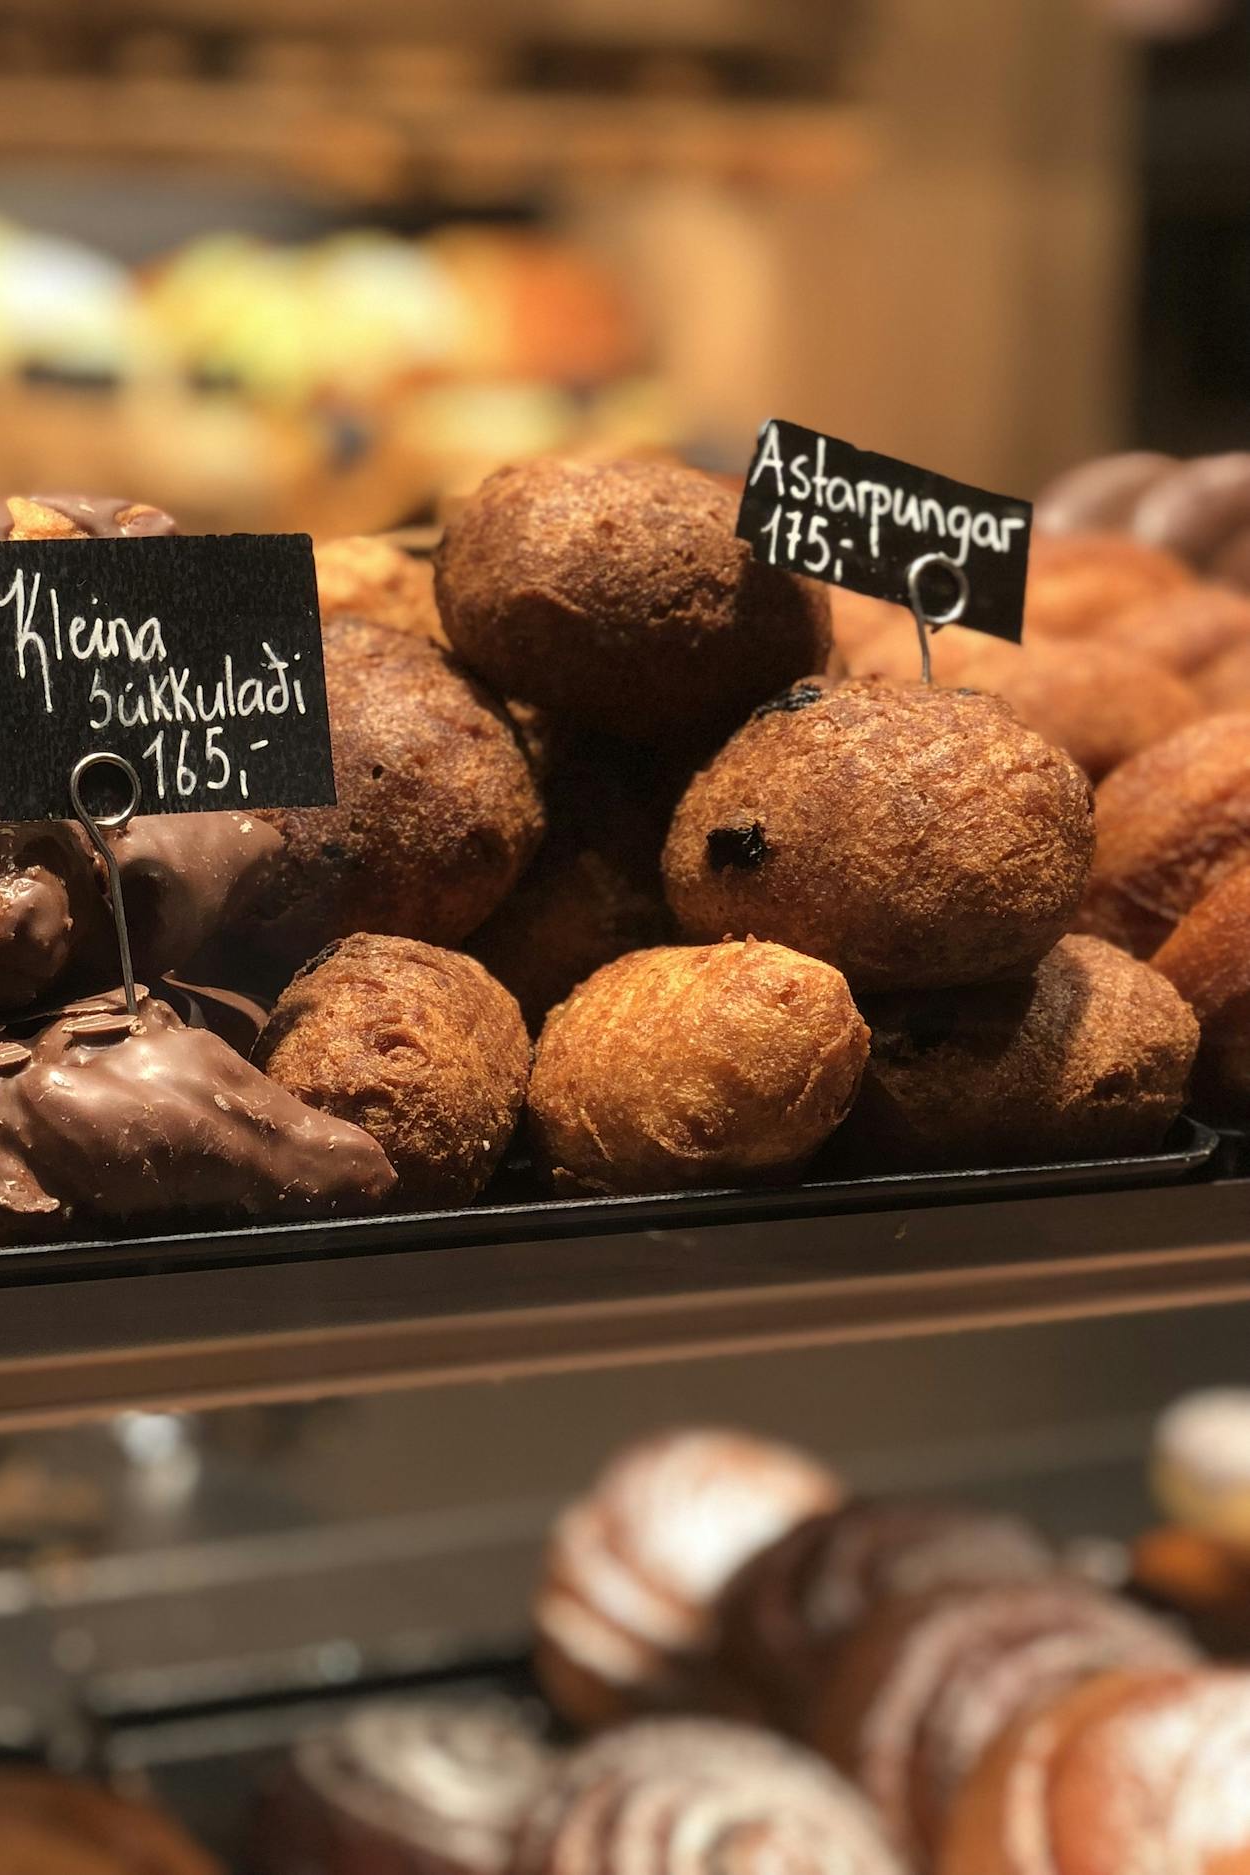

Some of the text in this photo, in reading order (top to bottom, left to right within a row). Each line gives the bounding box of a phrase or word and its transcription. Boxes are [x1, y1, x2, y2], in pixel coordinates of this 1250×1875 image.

[749, 421, 1026, 568] Astarpungar
[759, 503, 855, 583] 175,-
[141, 726, 270, 800] 165,-
